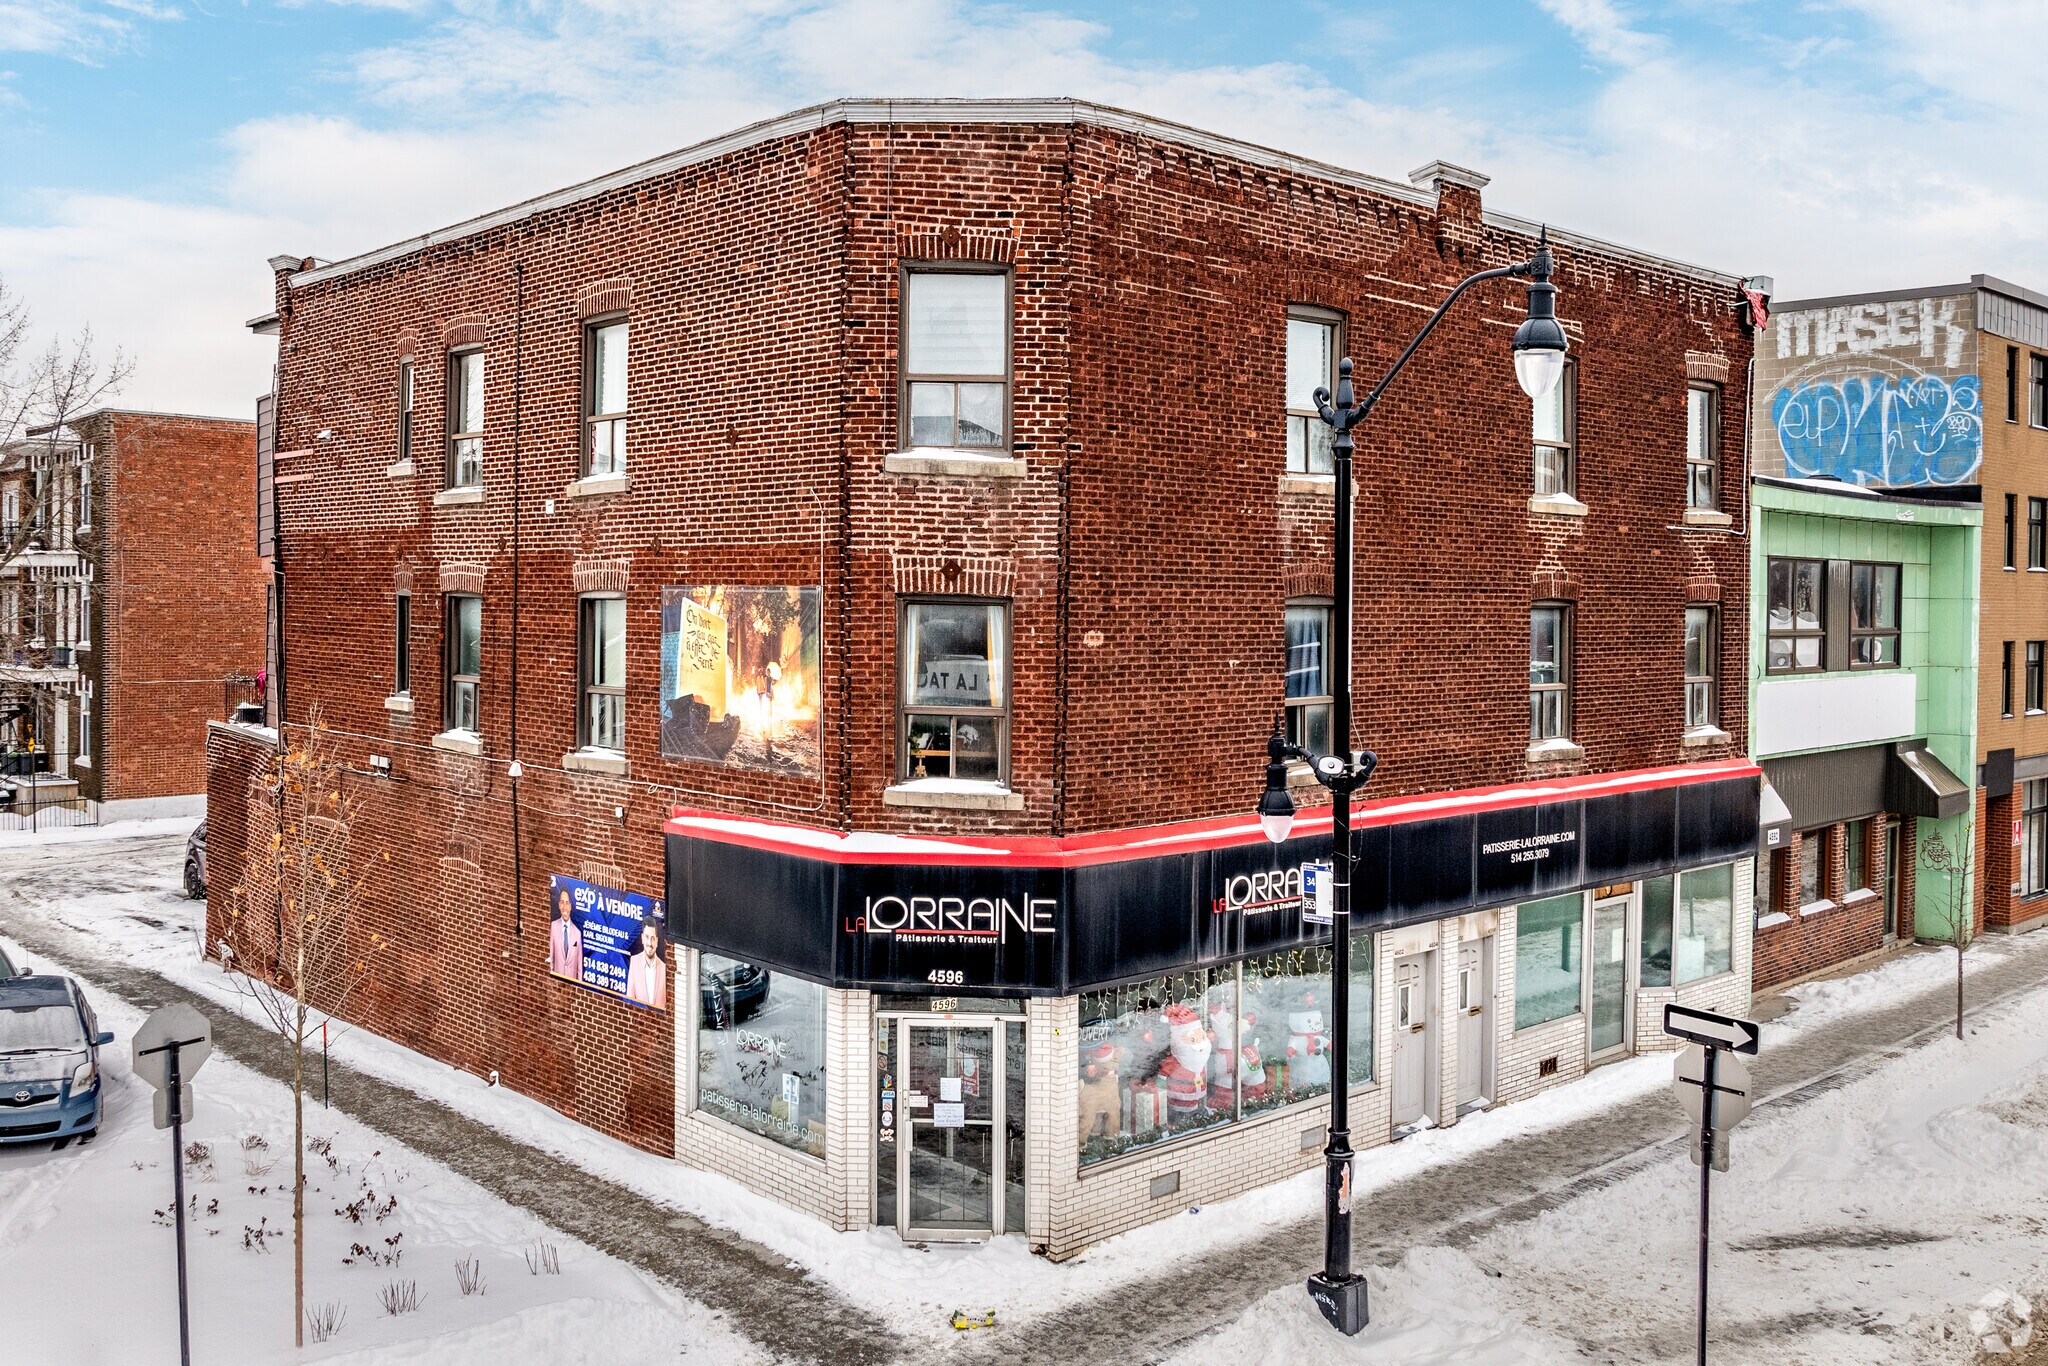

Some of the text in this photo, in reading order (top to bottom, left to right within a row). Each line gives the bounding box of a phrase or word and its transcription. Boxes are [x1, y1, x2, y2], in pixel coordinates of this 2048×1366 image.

[1483, 831, 1575, 854] PATISSERIE-LALORRAINE.COM
[1511, 848, 1550, 863] 514 255.3079
[1212, 867, 1302, 914] LA LORRA
[1306, 876, 1316, 887] 34
[597, 892, 605, 911] À
[605, 897, 644, 921] VENDRE
[1304, 899, 1316, 910] 353
[845, 892, 1057, 945] LA LORRAINE
[583, 929, 595, 940] KARL
[895, 934, 998, 944] Pâtisserie & Traiteur
[583, 956, 626, 979] 514 838 2494
[927, 970, 963, 984] 4596
[583, 970, 596, 984] 438
[609, 977, 627, 993] 7348
[932, 999, 956, 1011] 4596
[736, 1027, 787, 1060] LORRAINE
[701, 1088, 825, 1146] patisserie-lalorraine.com
